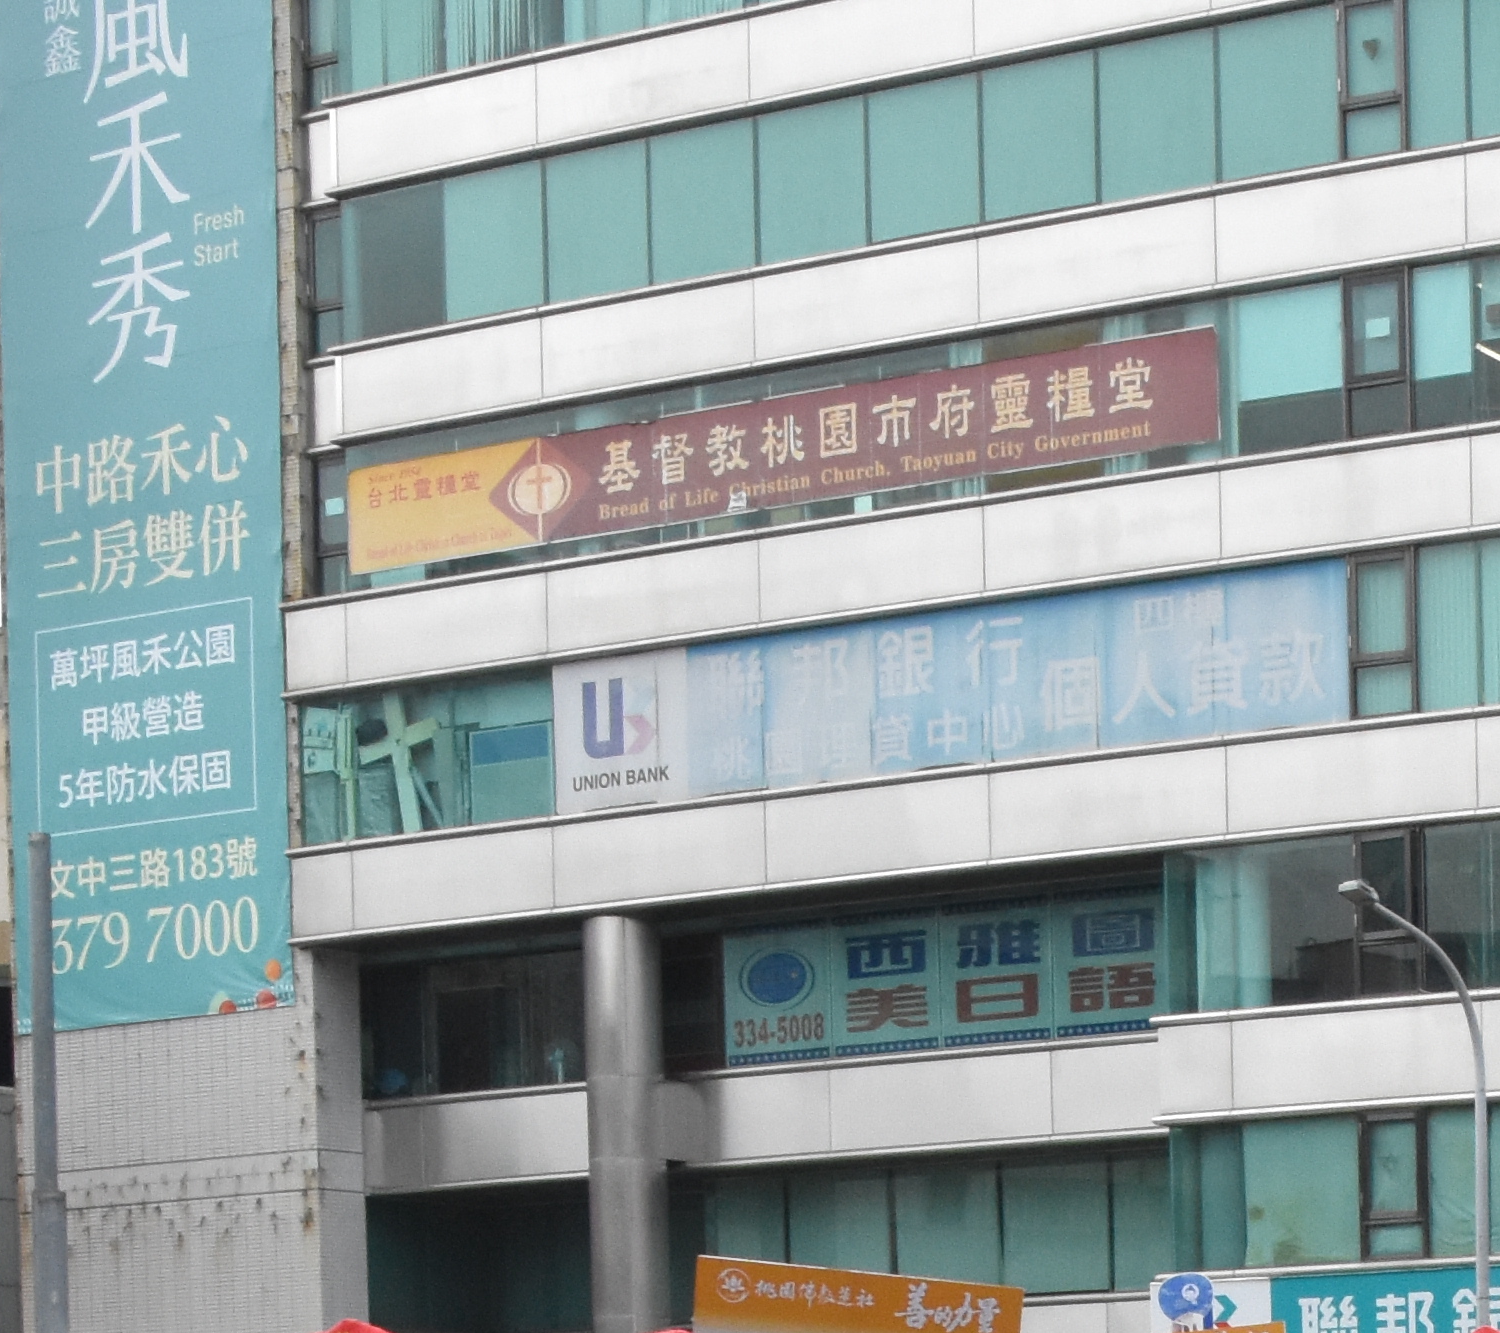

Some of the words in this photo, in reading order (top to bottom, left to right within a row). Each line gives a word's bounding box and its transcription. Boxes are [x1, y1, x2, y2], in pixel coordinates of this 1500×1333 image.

[83, 0, 191, 384] 風禾秀
[193, 204, 245, 236] Fresh
[194, 238, 240, 268] Start
[598, 357, 1154, 495] 基督教桃園市府靈糧堂
[34, 413, 249, 515] 中路禾心
[368, 471, 481, 509] 台北靈糧堂
[600, 497, 649, 521] Bread
[659, 492, 678, 511] of
[685, 488, 719, 509] Life
[729, 472, 810, 498] Christian
[900, 450, 977, 474] Taoyuan
[987, 440, 1025, 461] City
[1035, 421, 1152, 453] Government
[36, 499, 251, 600] 三房雙併
[49, 623, 236, 692] 萬坪風禾公園
[704, 616, 1024, 717] 聯邦銀行
[1041, 630, 1326, 731] 個人貸款
[82, 690, 205, 746] 甲級營造
[59, 749, 232, 809] 5年防水保固
[571, 771, 622, 792] UNION
[624, 765, 670, 789] BANK
[50, 836, 258, 901] 文中三路183號
[145, 896, 260, 964] 7000
[845, 907, 1155, 981] 西雅圖
[734, 1013, 824, 1048] 334-5008
[845, 961, 1156, 1033] 美日語
